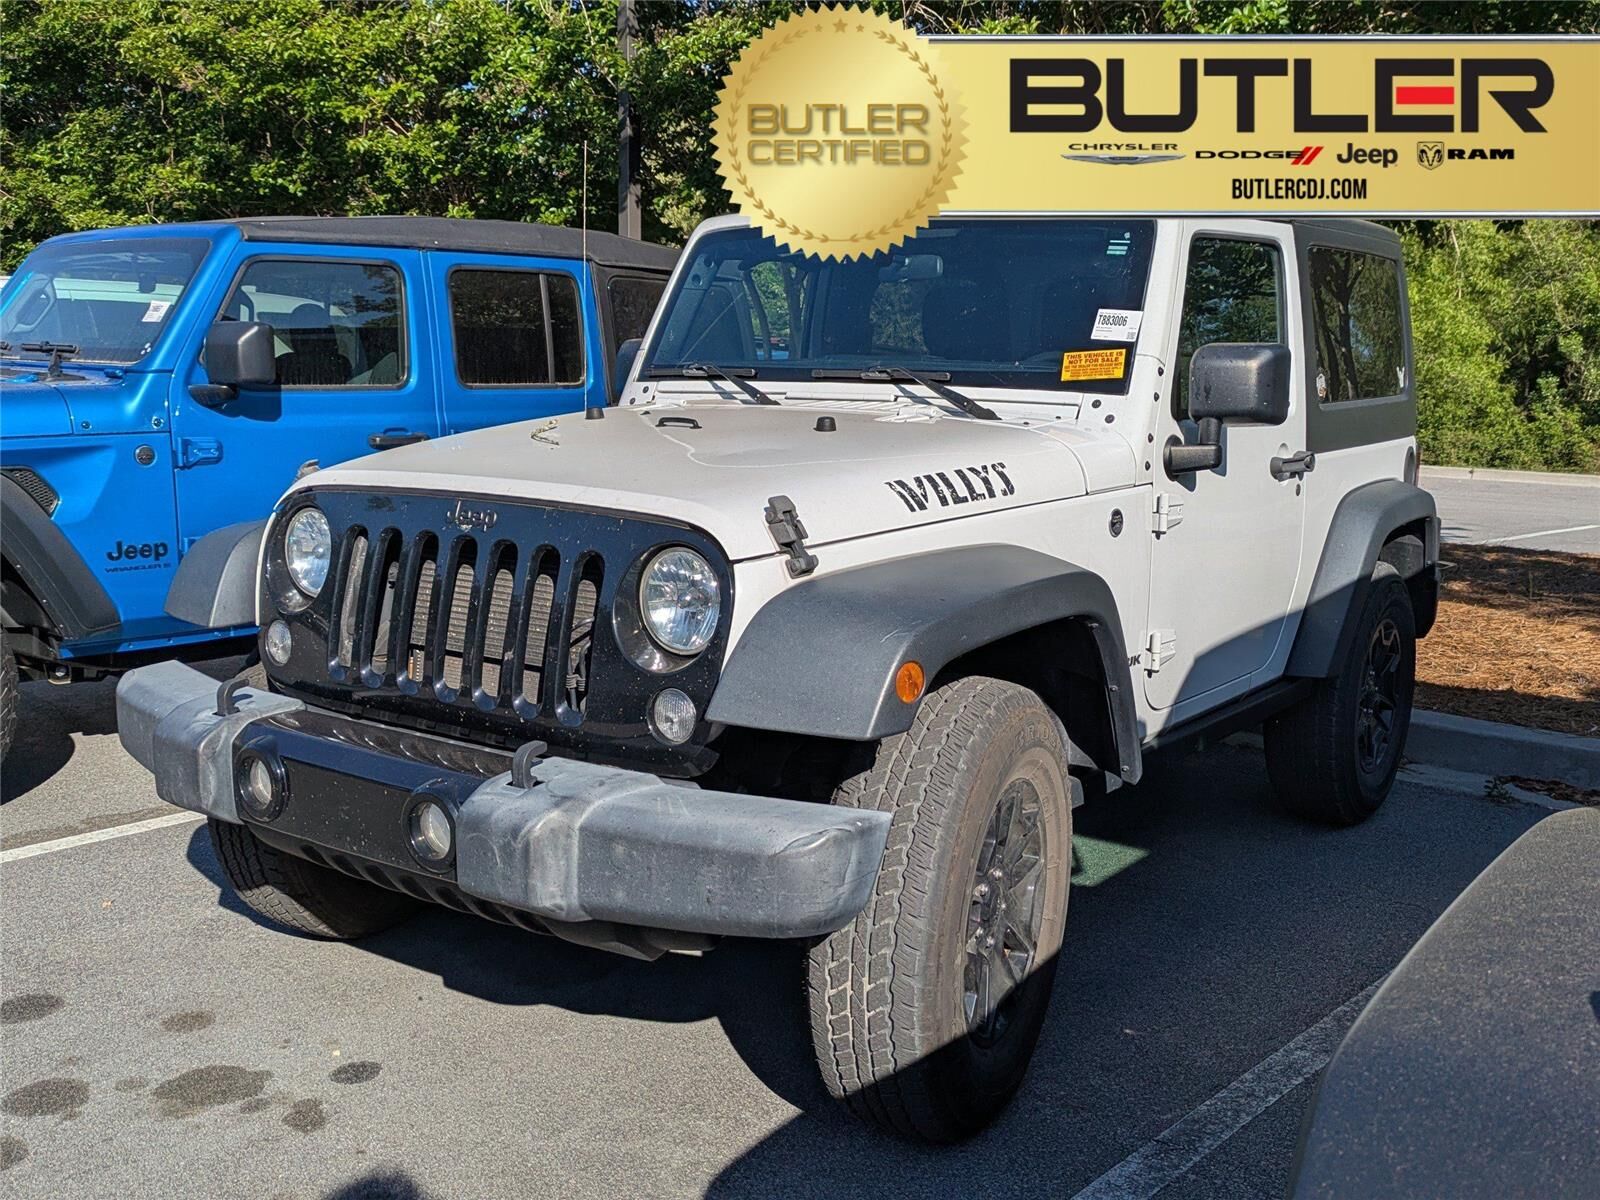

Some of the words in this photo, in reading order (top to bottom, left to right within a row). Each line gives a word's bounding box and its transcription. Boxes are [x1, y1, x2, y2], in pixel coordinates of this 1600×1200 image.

[1097, 314, 1128, 327] T883006
[884, 462, 1015, 512] WILLYS
[446, 500, 498, 532] Jeep
[106, 541, 168, 561] Jeep
[104, 562, 161, 573] WRANGLER
